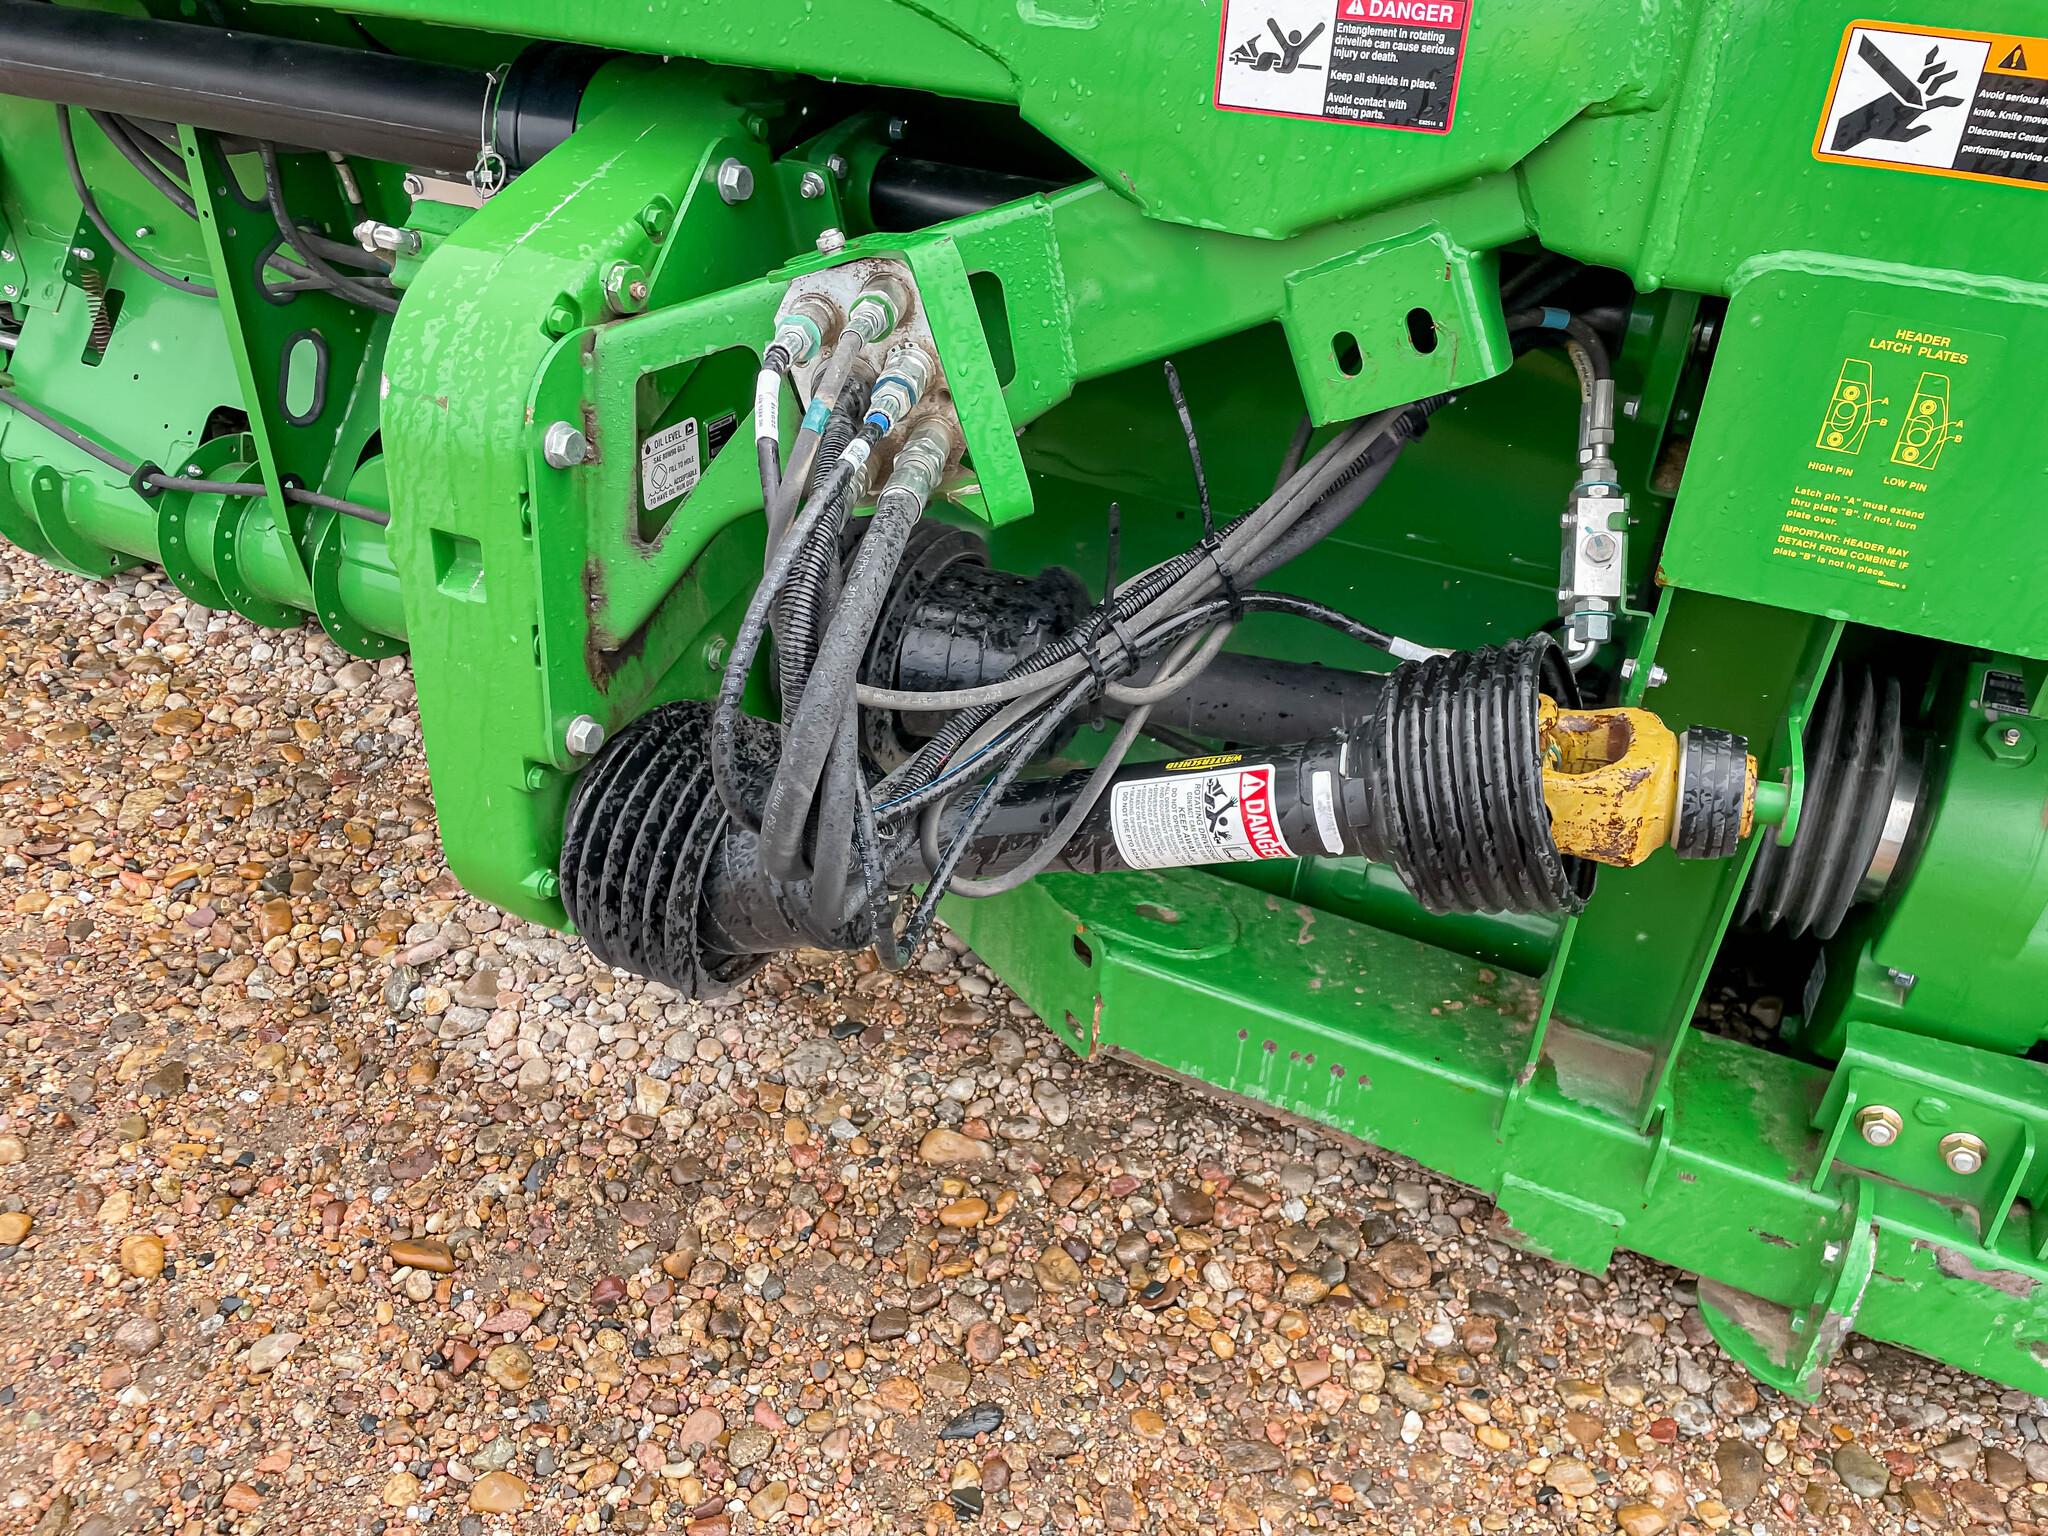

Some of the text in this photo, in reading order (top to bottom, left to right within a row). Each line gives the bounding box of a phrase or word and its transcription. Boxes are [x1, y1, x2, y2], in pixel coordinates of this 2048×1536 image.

[1369, 0, 1454, 23] DANGER
[1336, 23, 1445, 44] Entanglement in rotating
[1334, 35, 1454, 55] driveline can cause serious
[1332, 47, 1399, 62] injury or death.
[1329, 69, 1437, 91] Keep all shields in place.
[1326, 92, 1406, 109] Avoid contact with
[1978, 88, 2004, 100] Avoid
[2005, 92, 2039, 104] serious
[1325, 105, 1385, 121] rotating parts.
[1972, 107, 2048, 125] knife. Knife move
[1967, 125, 2048, 143] Disconnect Center
[1960, 144, 2009, 158] performing
[2010, 150, 2043, 161] service
[1895, 328, 1951, 348] HEADER
[1868, 337, 1968, 365] LATCH PLATES
[1881, 396, 1890, 405] A
[1878, 417, 1888, 426] B
[1955, 419, 1964, 428] A
[654, 430, 682, 449] OIL LEVEL
[1953, 434, 1962, 443] B
[668, 456, 695, 473] FILL TO HOLE
[1807, 460, 1854, 477] HIGH PIN
[674, 469, 698, 485] ACCEPTABLE
[1882, 475, 1927, 492] LOW PIN
[650, 495, 656, 505] TO
[657, 490, 668, 502] HAVE
[1794, 485, 1822, 498] Latch
[1823, 491, 1841, 503] pin
[1862, 499, 1888, 511] must
[1889, 504, 1925, 519] extend
[1785, 508, 1837, 526] plate over.
[1790, 497, 1811, 508] thru
[1812, 502, 1838, 515] plate
[1863, 511, 1872, 520] If
[1872, 514, 1893, 526] not,
[1895, 519, 1916, 530] turn
[1780, 524, 1909, 557] IMPORTANT: HEADER MAY
[1777, 535, 1909, 570] DETACH FROM COMBINE IF
[1772, 546, 1797, 558] plate
[1816, 555, 1826, 564] is
[1827, 558, 1844, 568] not
[1846, 561, 1856, 570] in
[1857, 564, 1886, 578] place.
[1165, 754, 1242, 769] WALTERSCHEID
[770, 780, 787, 810] 3000
[1122, 791, 1128, 801] DO
[1171, 787, 1177, 797] DO
[1193, 783, 1203, 825] ROTATING
[764, 813, 778, 833] PSI
[1122, 818, 1130, 832] USE
[1148, 818, 1154, 826] AT
[1178, 806, 1188, 831] KEEP
[1186, 791, 1194, 818] CONTACT
[1192, 833, 1202, 849] CAUSE
[1172, 814, 1184, 844] OPERATE
[1125, 834, 1135, 847] PTO
